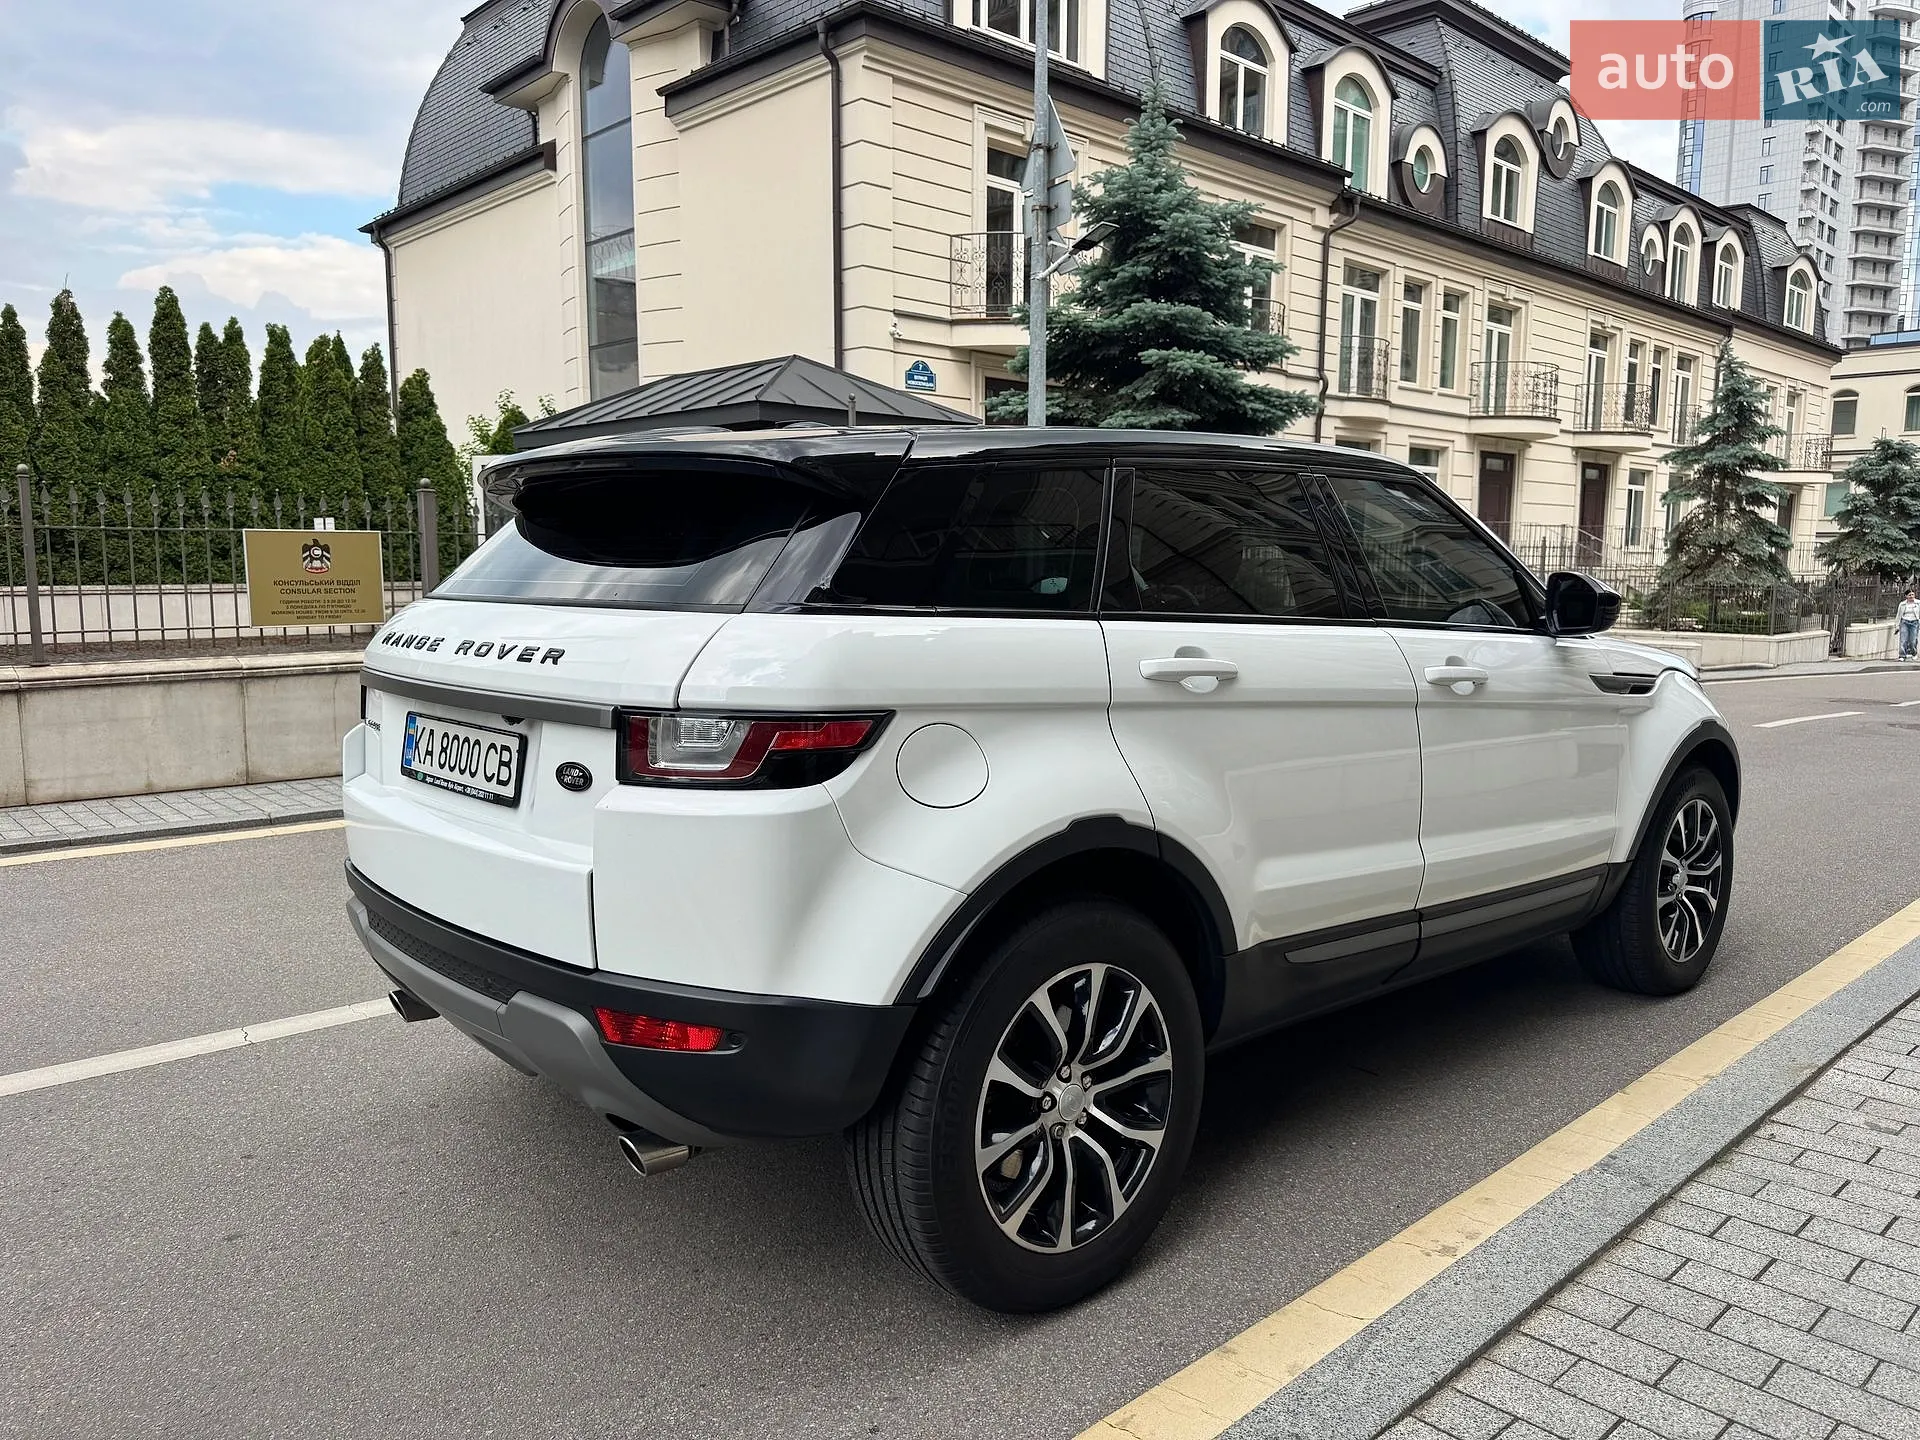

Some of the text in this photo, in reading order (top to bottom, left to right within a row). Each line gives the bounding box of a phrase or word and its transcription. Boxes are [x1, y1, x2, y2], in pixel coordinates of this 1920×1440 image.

[273, 578, 361, 588] КОНСУЛЬСЬКИЙ ВІДДІЛ
[279, 587, 322, 595] CONSULAR
[381, 632, 566, 666] RANGE ROVER
[412, 724, 513, 787] KA 8000 CB
[563, 767, 579, 776] LAND
[563, 775, 584, 786] ROVER
